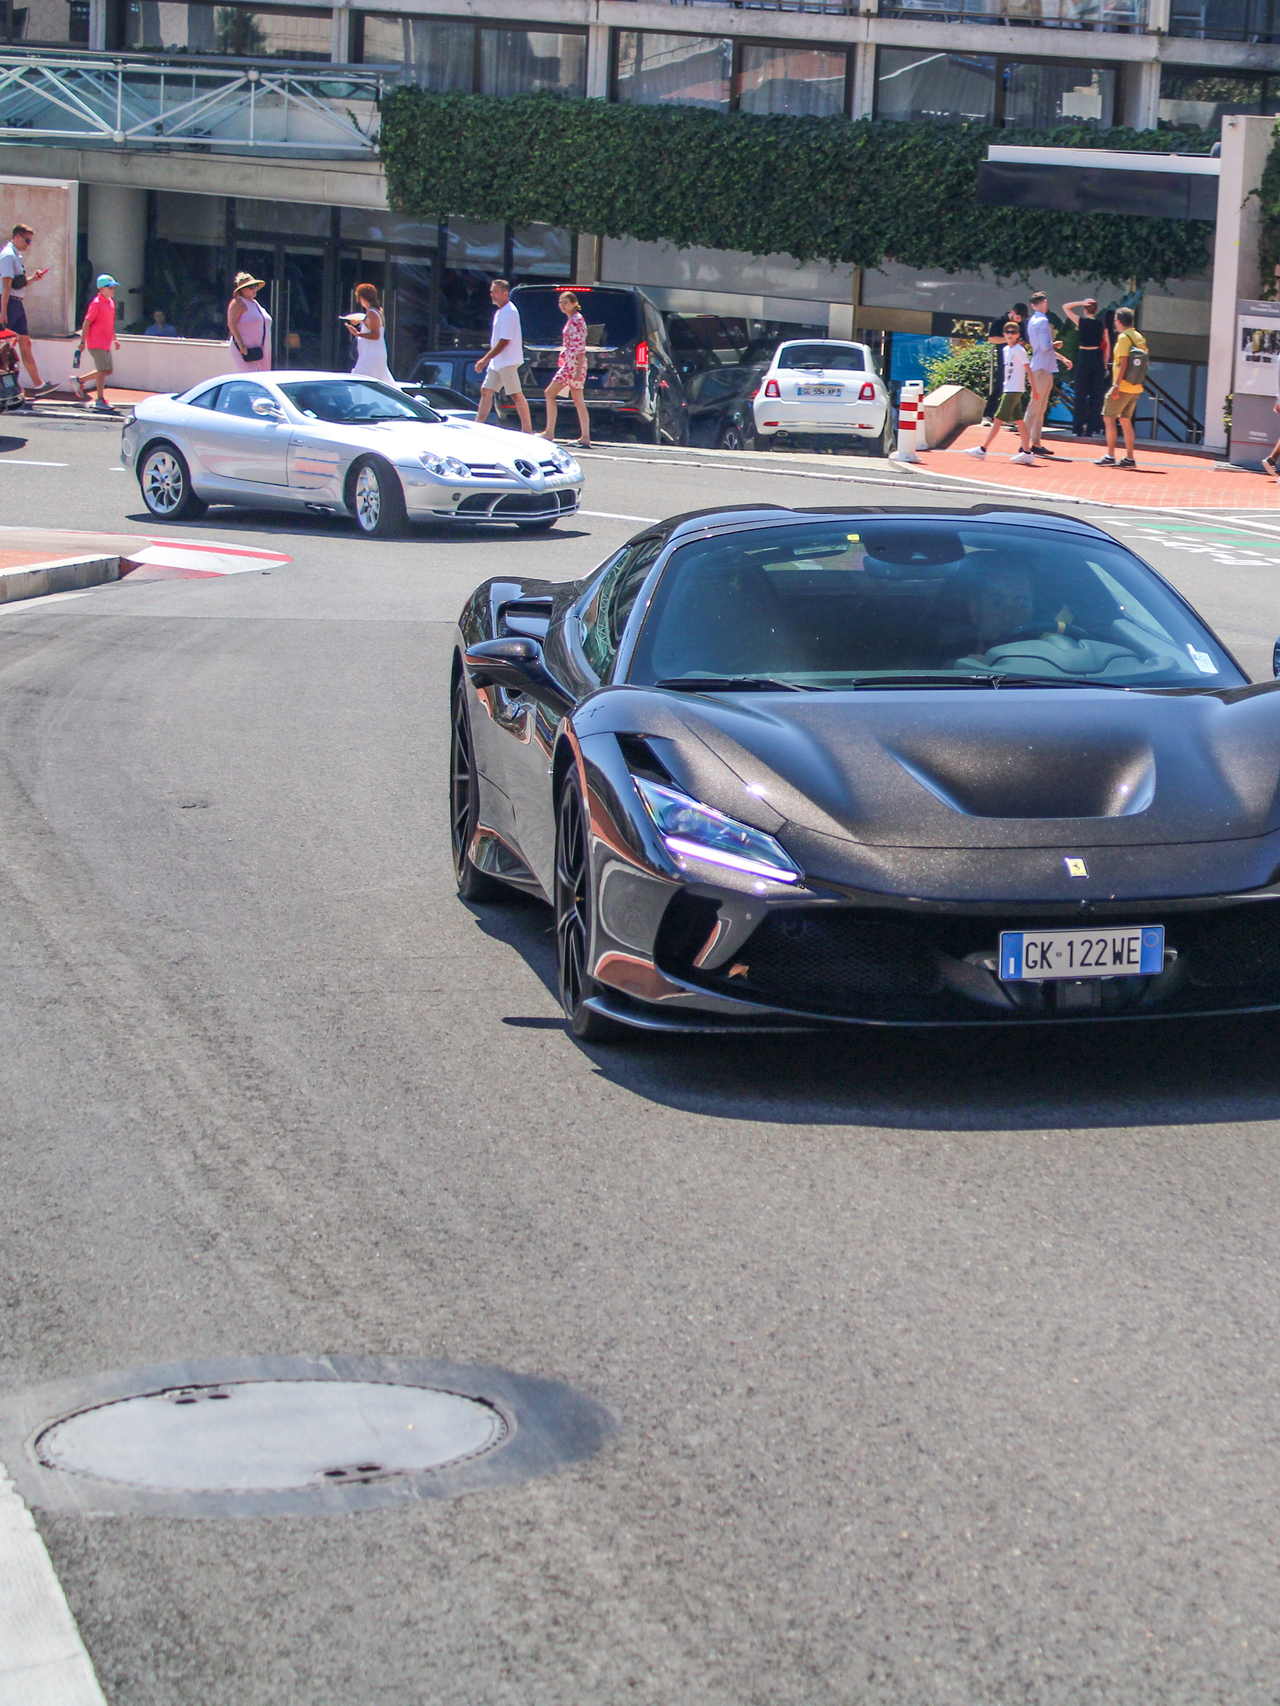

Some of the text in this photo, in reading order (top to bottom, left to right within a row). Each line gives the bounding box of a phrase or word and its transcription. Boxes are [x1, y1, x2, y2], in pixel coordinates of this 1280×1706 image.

[951, 319, 992, 337] XERJ
[1025, 941, 1054, 969] GK
[1068, 937, 1140, 967] 122WE
